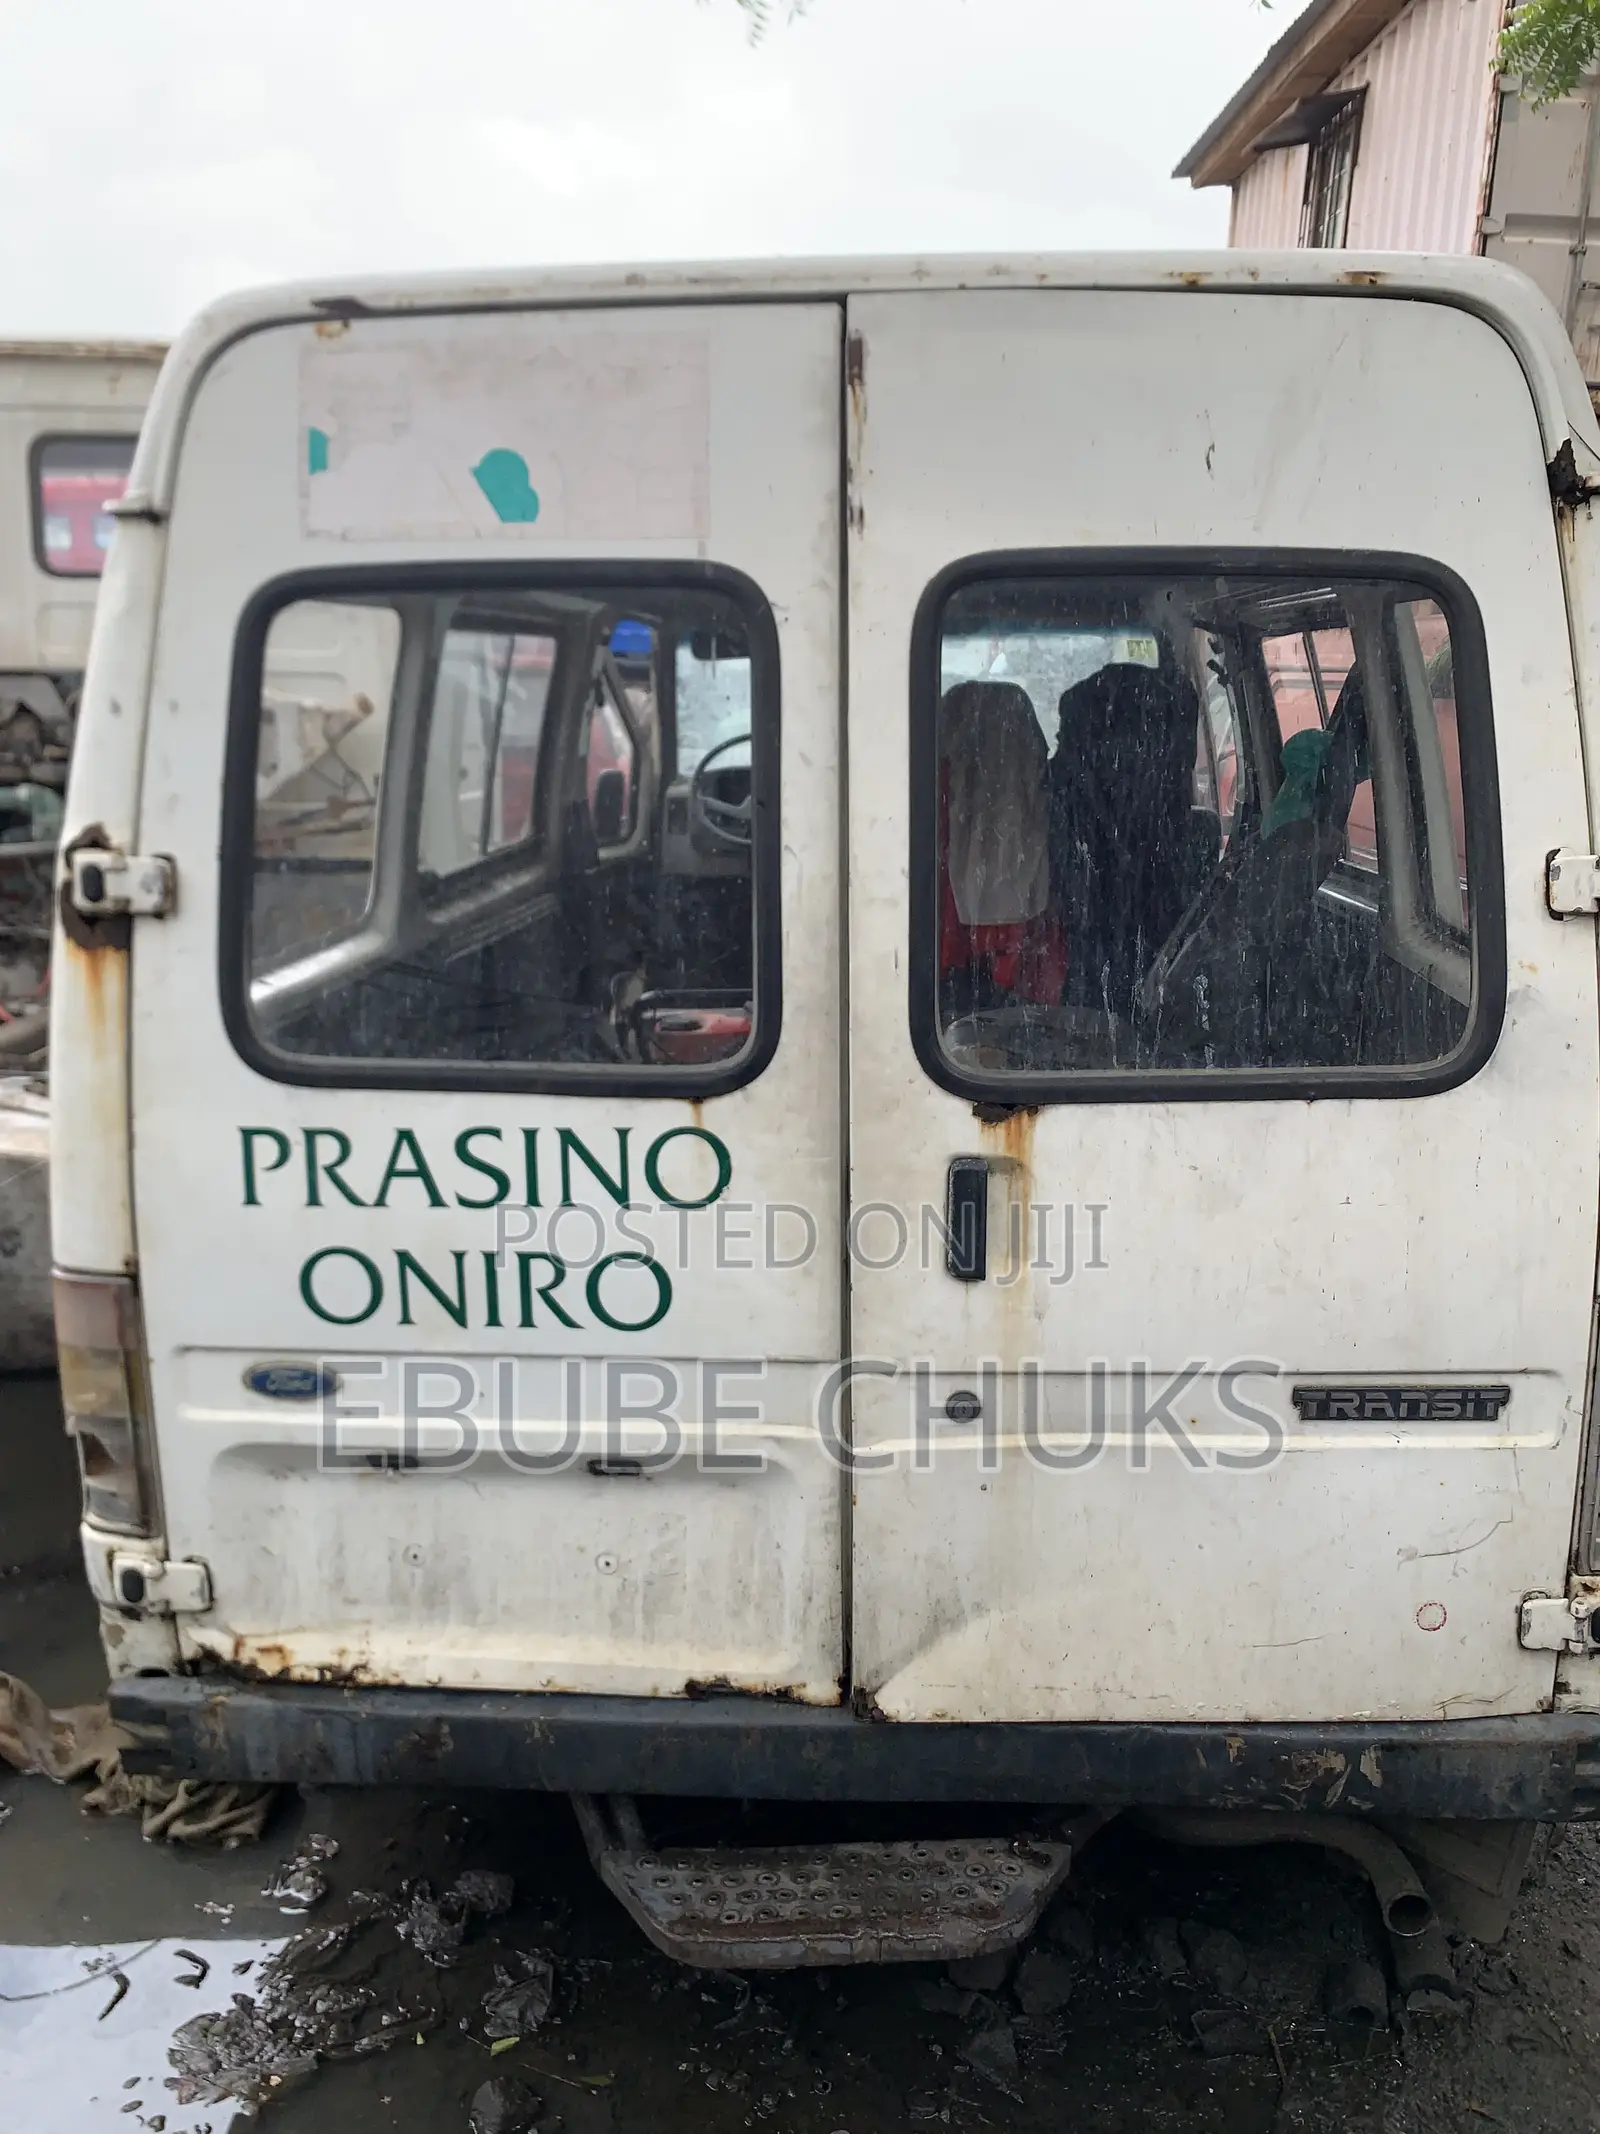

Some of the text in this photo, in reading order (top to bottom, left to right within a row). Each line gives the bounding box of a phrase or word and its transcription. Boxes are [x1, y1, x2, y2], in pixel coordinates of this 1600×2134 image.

[239, 1126, 732, 1209] PRASINO
[300, 1246, 673, 1331] ONIRO
[1299, 1390, 1509, 1419] TRANSIT
